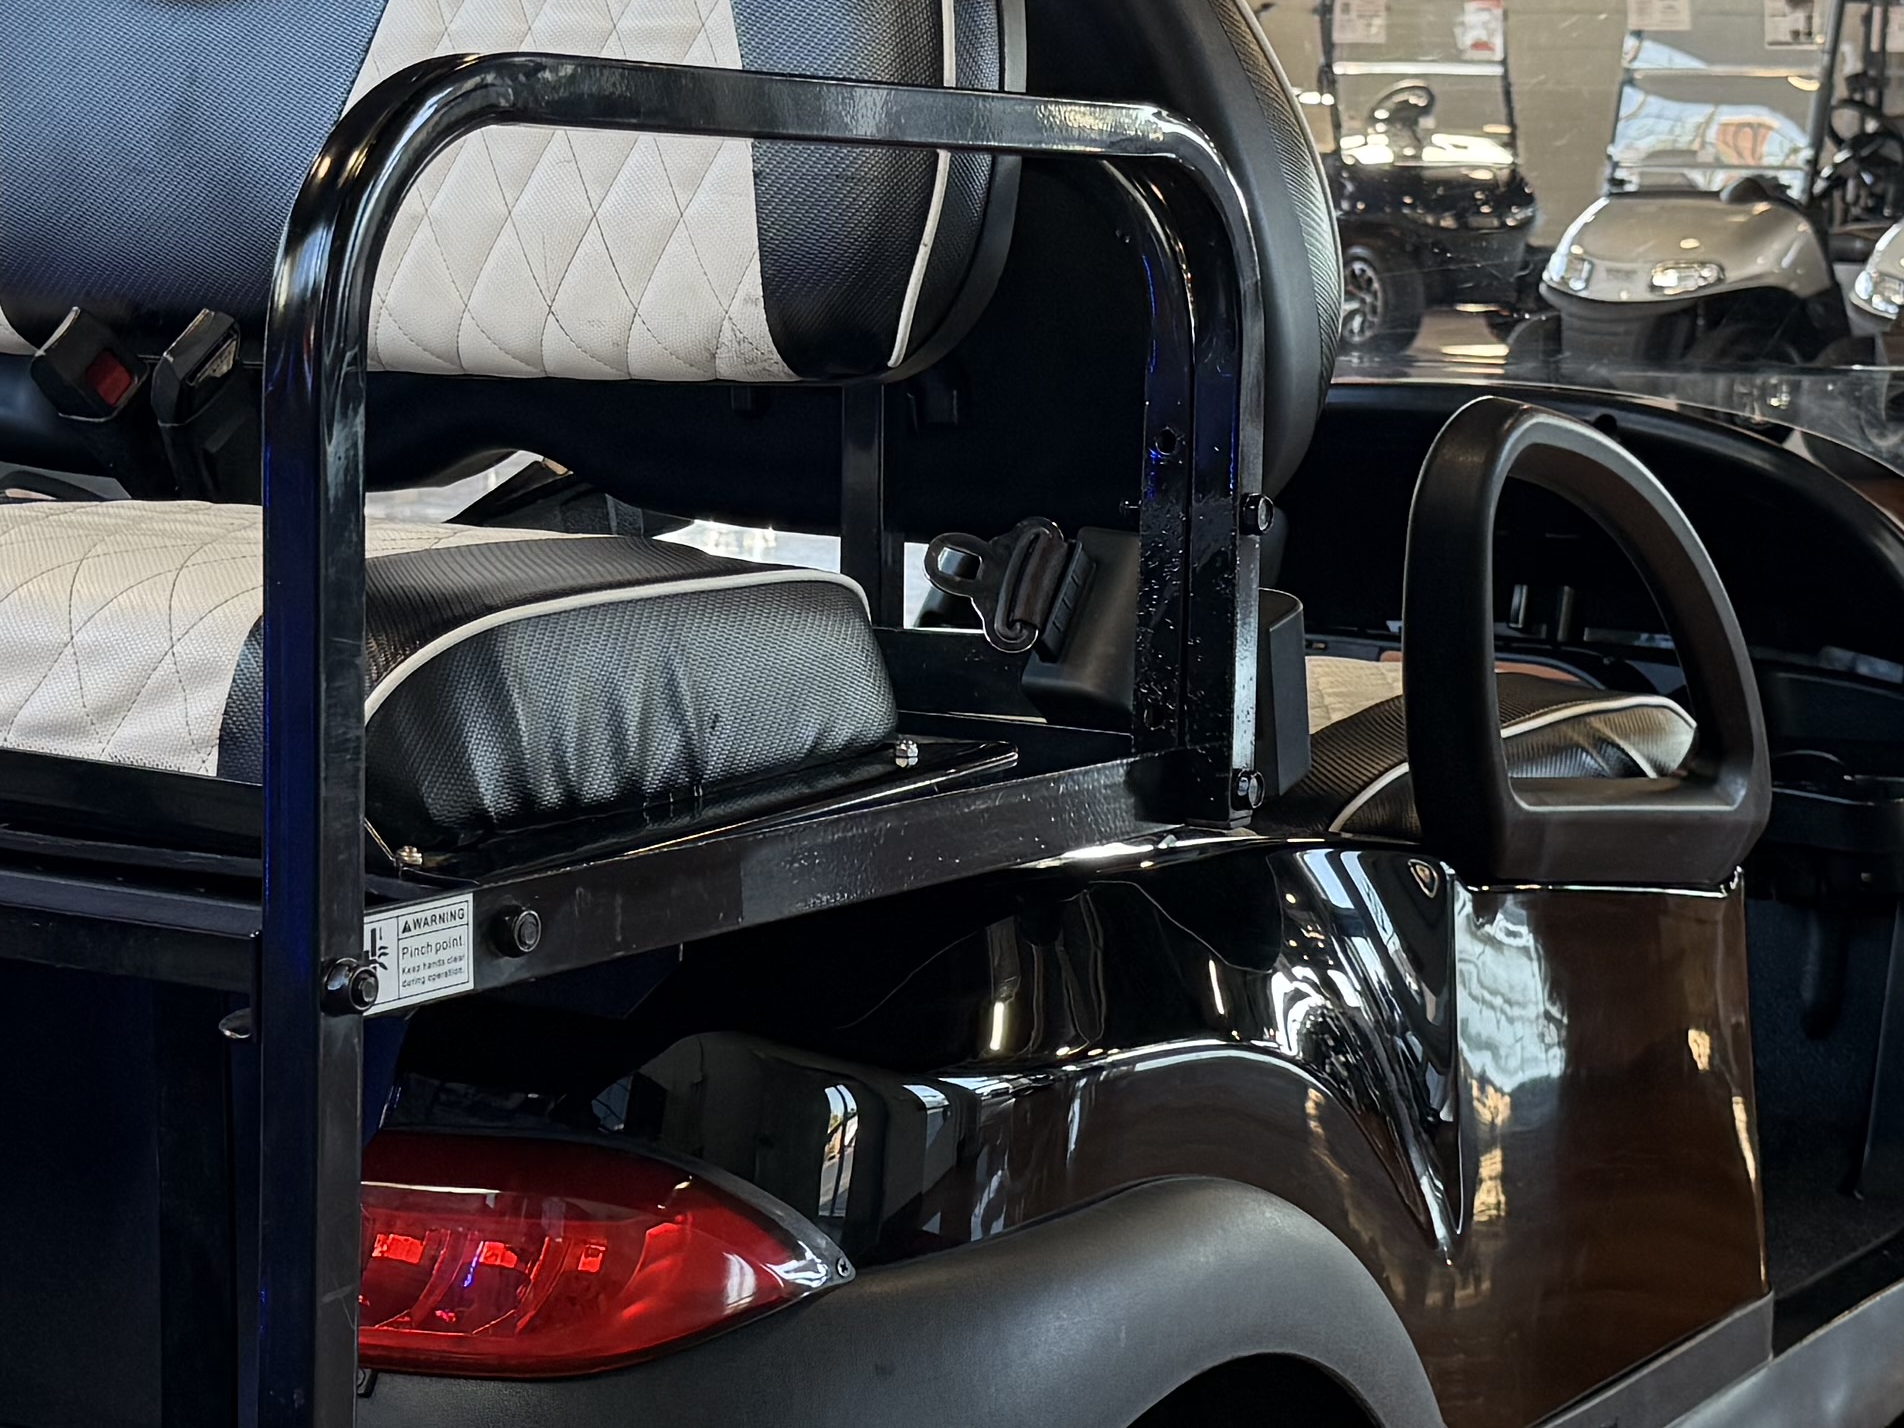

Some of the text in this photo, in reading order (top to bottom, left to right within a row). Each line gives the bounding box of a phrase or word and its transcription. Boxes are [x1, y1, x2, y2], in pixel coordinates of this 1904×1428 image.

[412, 908, 465, 931] WARNING
[402, 942, 433, 960] Pinch
[402, 964, 421, 975] Keep
[423, 958, 445, 971] hands
